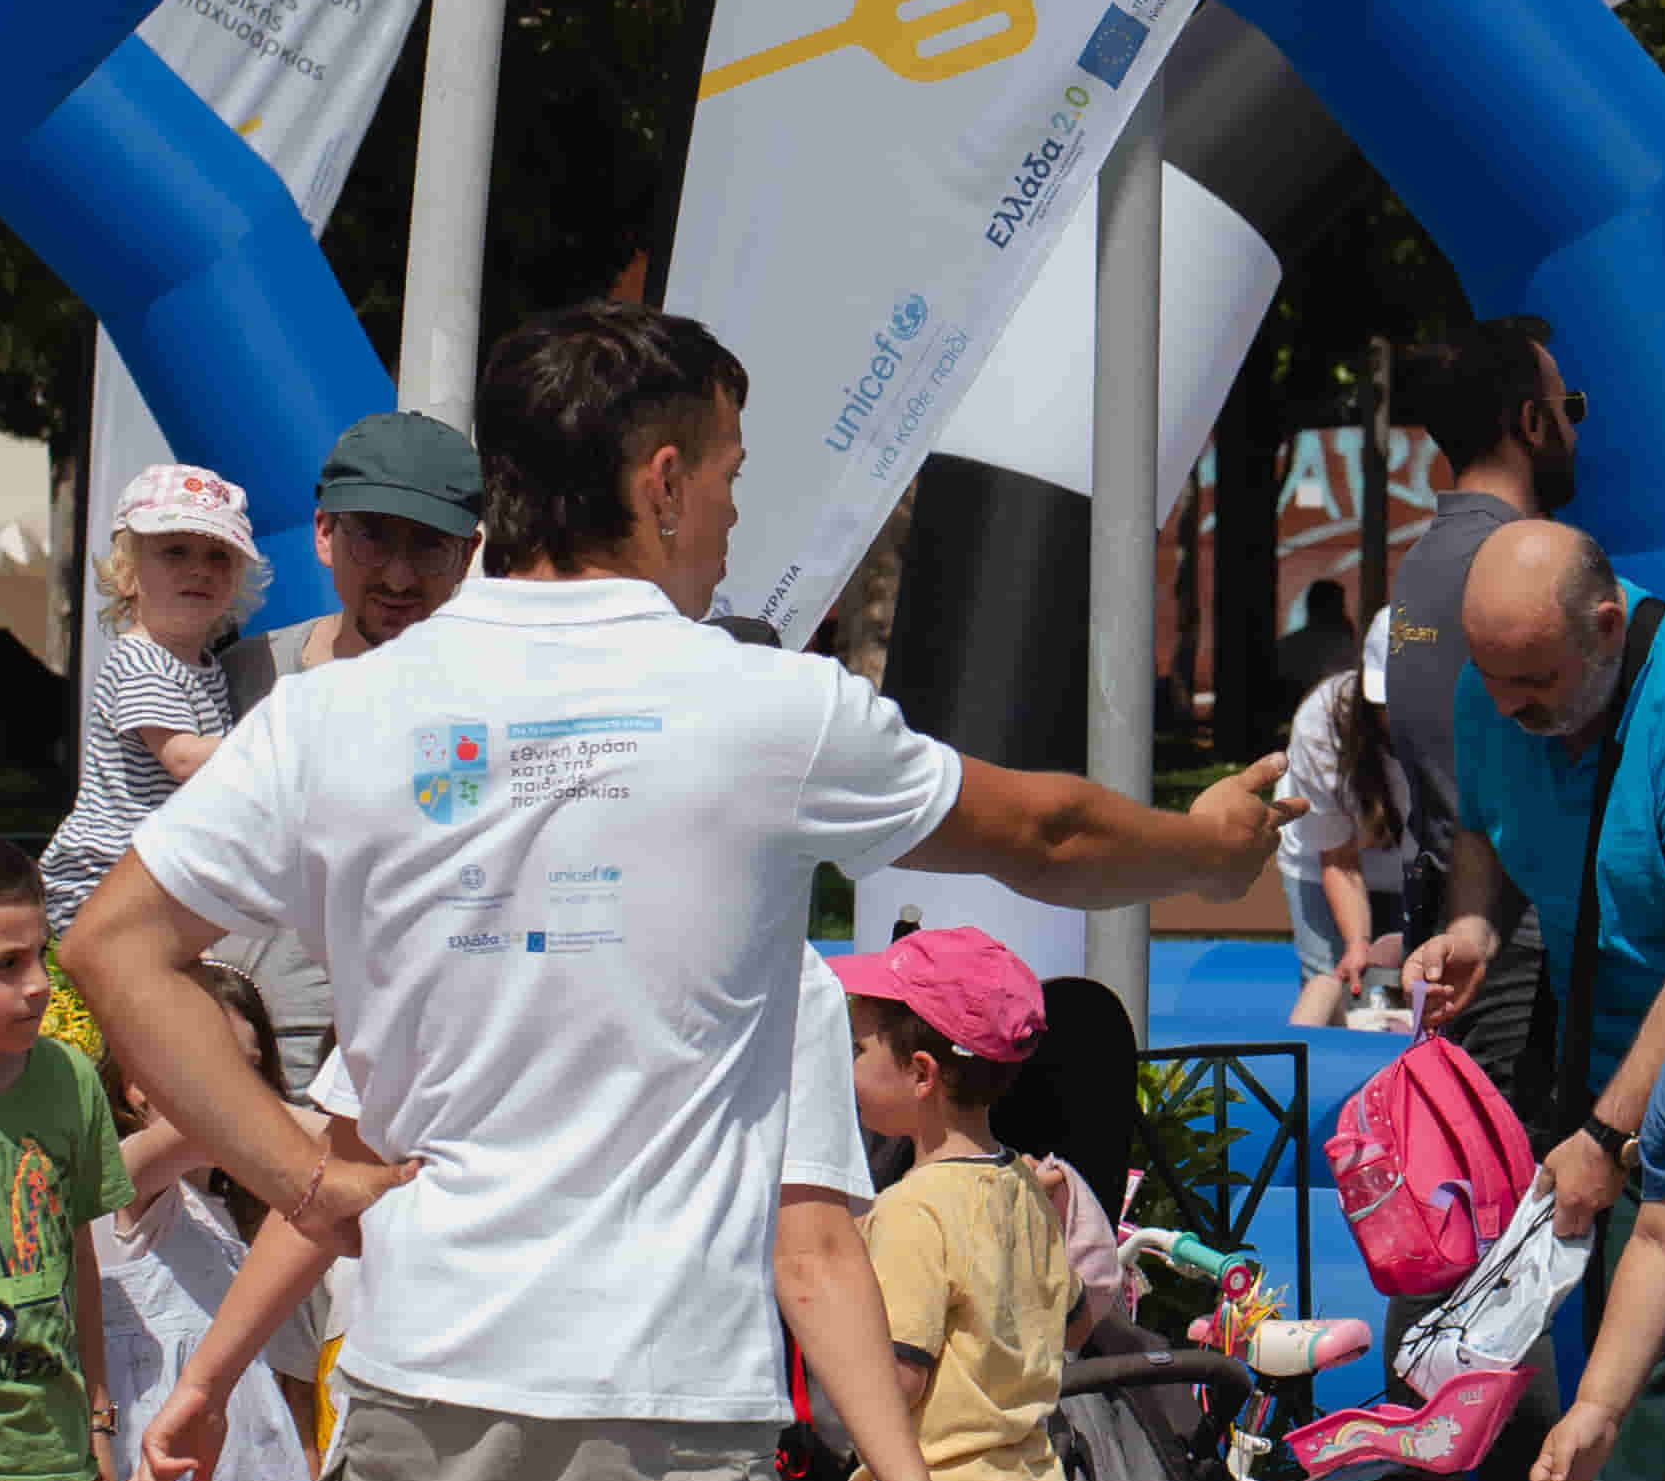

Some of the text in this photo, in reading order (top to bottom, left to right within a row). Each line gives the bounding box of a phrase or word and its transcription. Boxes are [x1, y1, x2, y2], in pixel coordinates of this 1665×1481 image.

[985, 135, 1065, 250] Ελλάδα
[824, 332, 902, 452] unicef
[760, 563, 802, 622] ΚΡΑΤΙΑ
